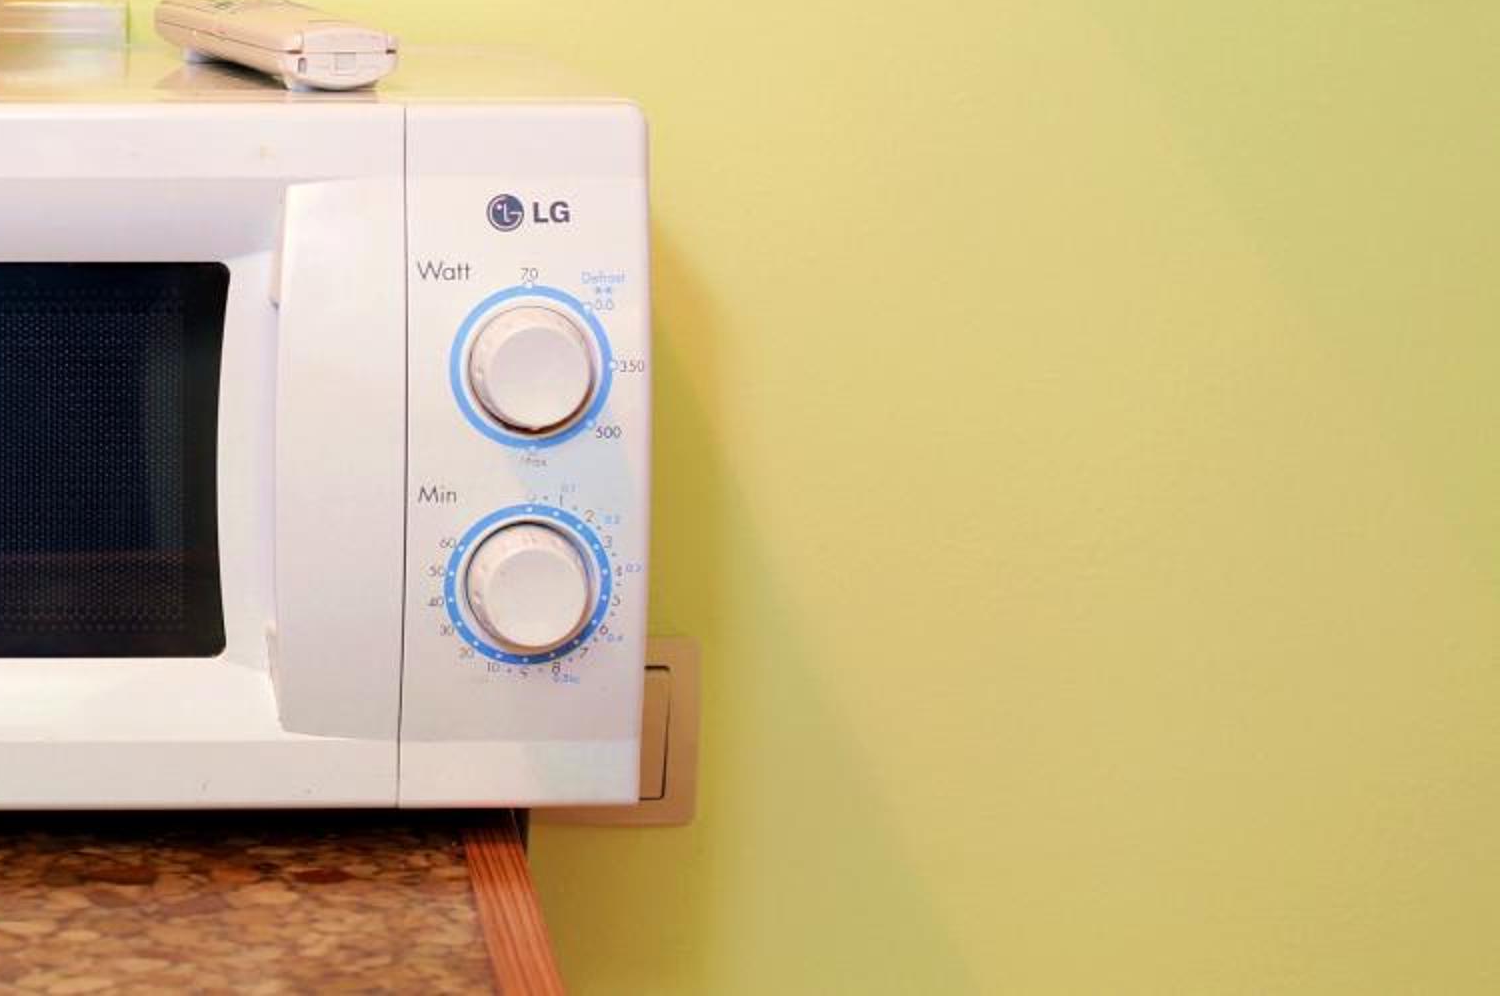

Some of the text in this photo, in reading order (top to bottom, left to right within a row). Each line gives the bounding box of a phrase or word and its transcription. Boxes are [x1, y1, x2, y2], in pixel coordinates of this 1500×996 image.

[532, 200, 571, 223] LG
[417, 260, 471, 281] Watt
[595, 426, 622, 439] 500
[418, 485, 457, 503] Min
